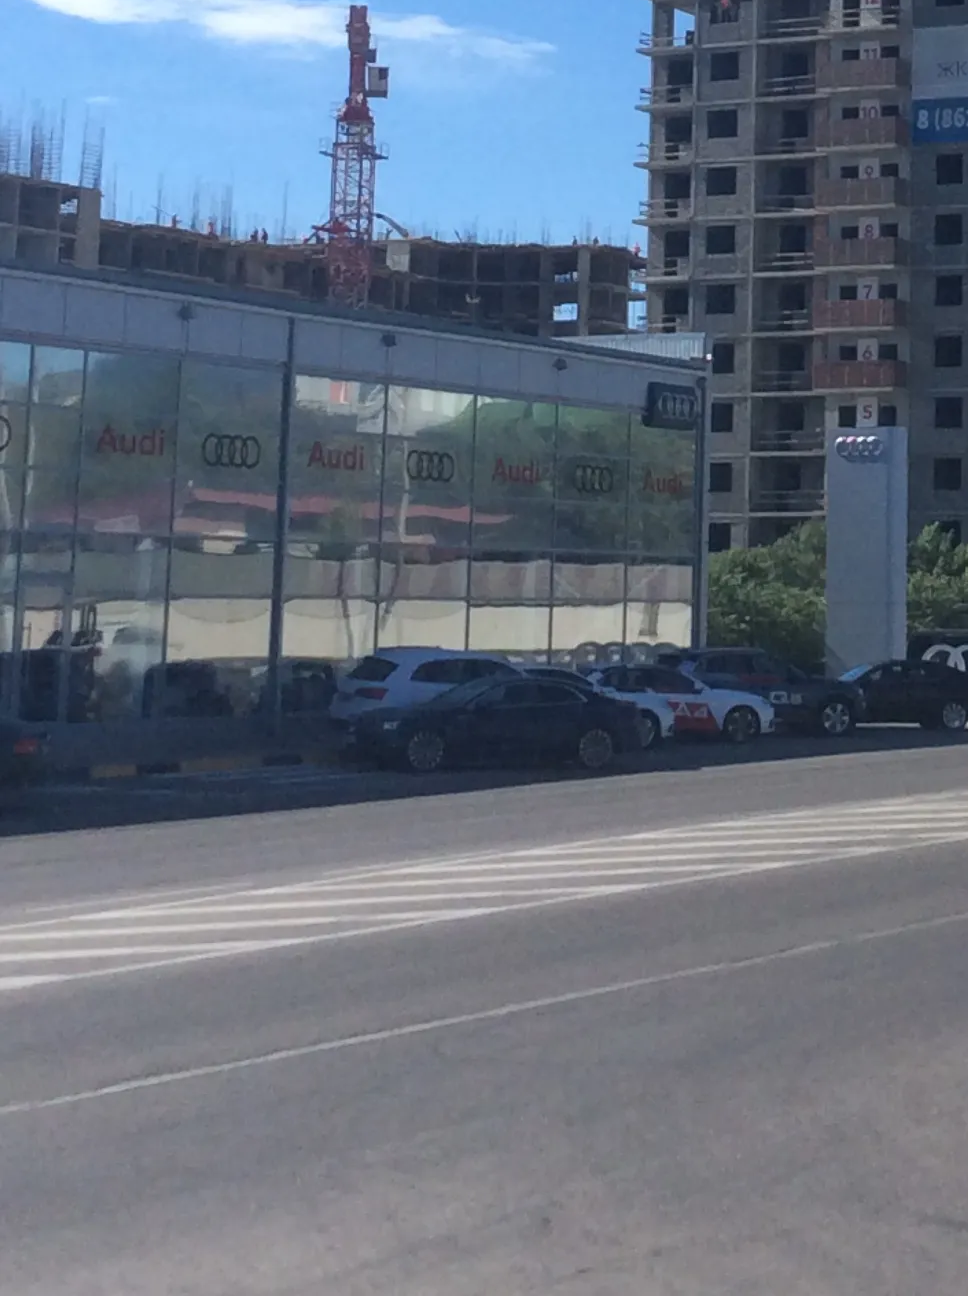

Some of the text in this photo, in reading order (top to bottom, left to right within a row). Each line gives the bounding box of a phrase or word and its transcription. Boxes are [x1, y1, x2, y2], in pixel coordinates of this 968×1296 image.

[938, 61, 967, 78] ЖК
[861, 106, 878, 120] 10
[917, 109, 929, 129] 8
[863, 285, 872, 299] 7
[862, 345, 872, 360] 6
[863, 405, 872, 419] 5
[96, 423, 165, 455] Audi
[308, 441, 364, 470] Audi
[492, 458, 541, 483] Audi
[642, 468, 683, 494] Audi
